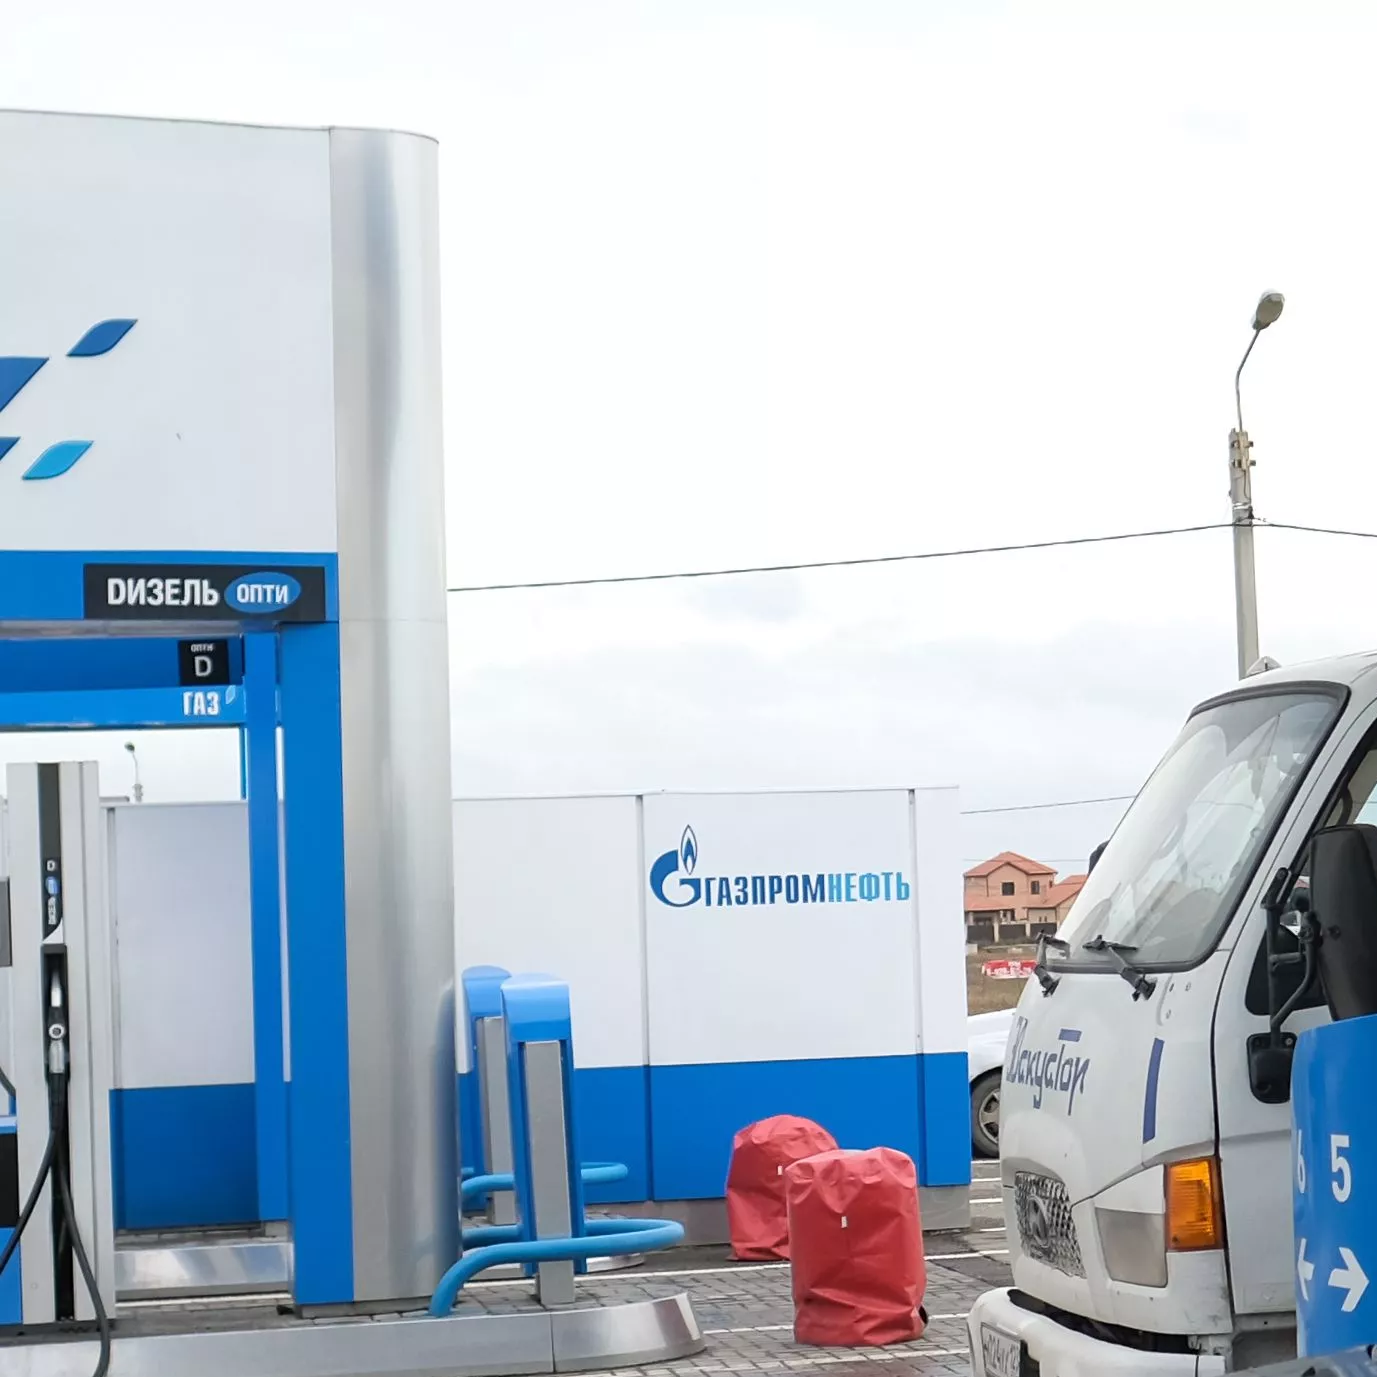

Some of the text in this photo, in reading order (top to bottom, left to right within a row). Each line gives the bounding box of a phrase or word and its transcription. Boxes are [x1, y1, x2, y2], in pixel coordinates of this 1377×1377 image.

[236, 583, 290, 604] ОПТИ
[195, 655, 213, 677] D
[183, 691, 220, 716] ГАЗ
[705, 872, 911, 908] ГАЗПРОМНЕФТЬ
[1330, 1134, 1351, 1203] 5
